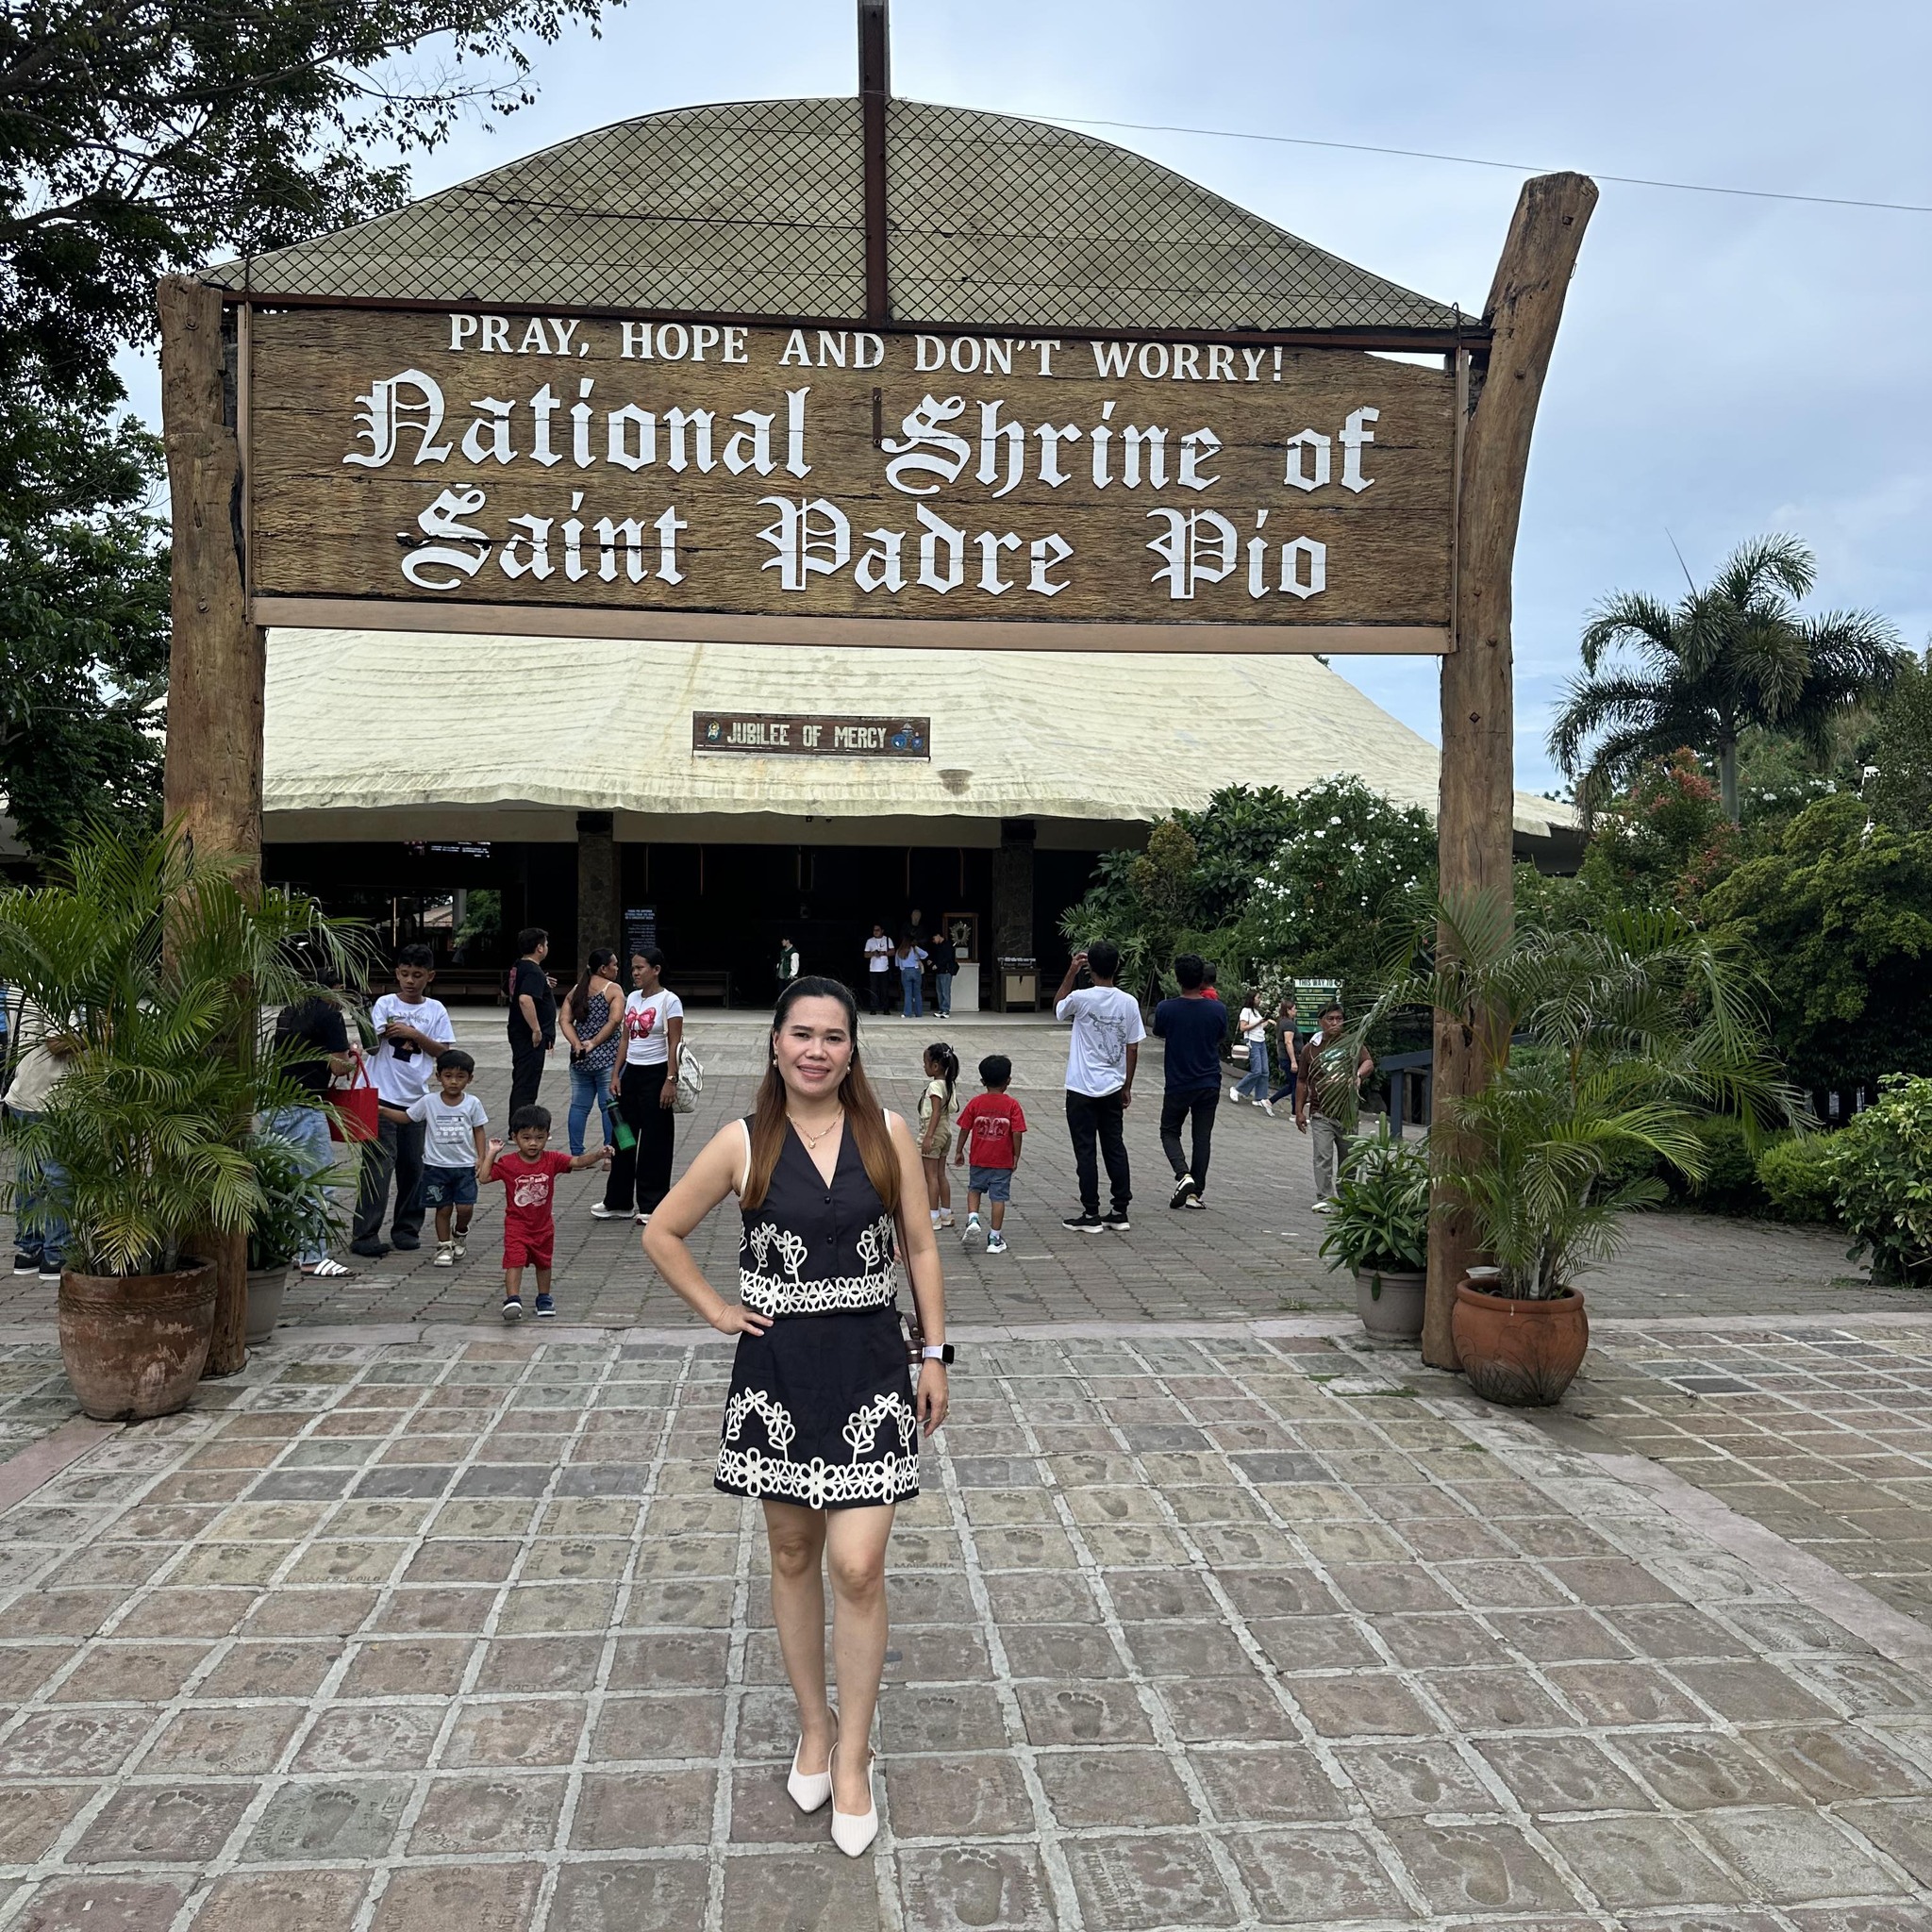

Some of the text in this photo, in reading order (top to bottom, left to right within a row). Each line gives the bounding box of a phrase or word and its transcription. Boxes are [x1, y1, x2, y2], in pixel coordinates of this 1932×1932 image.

[448, 313, 1283, 381] PRAY, HOPE AND DON'T WORRY!
[342, 369, 1380, 497] National Shrine of
[397, 483, 1326, 600] Saint Padre Pio
[726, 722, 887, 749] JUBILEE OF MERCY
[1298, 978, 1311, 987] THIS
[1312, 978, 1325, 987] WAY
